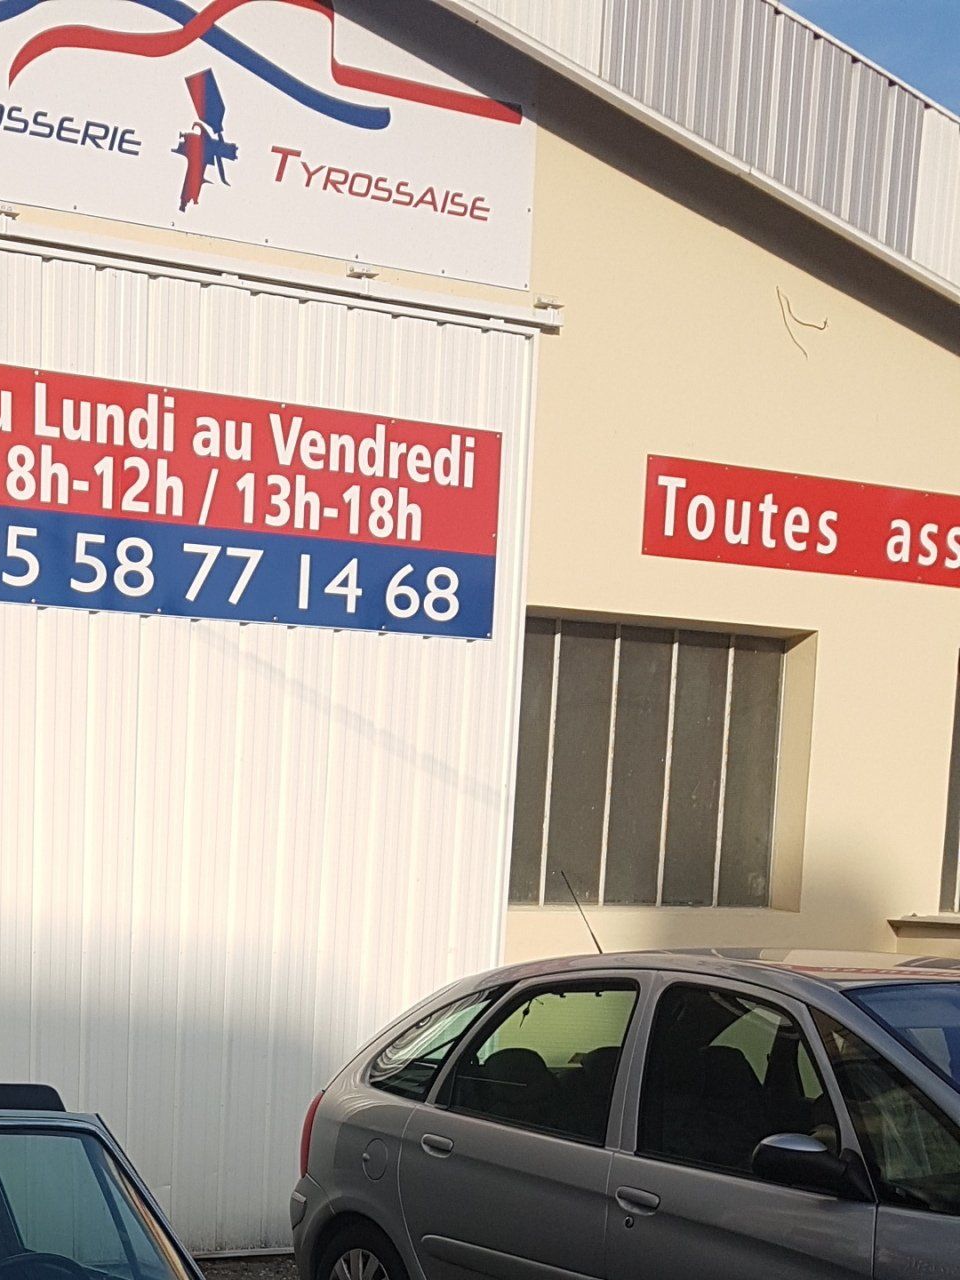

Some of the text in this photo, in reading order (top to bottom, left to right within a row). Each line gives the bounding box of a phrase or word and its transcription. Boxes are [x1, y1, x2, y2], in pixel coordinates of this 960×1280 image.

[270, 145, 491, 222] TYROSSAISE
[34, 381, 175, 452] Lundi
[192, 415, 252, 462] au
[269, 413, 475, 488] Vendredi
[5, 444, 183, 517] 8h-12h
[236, 472, 422, 542] 13h-18h
[657, 475, 839, 555] Toutes
[69, 532, 155, 597] 58
[182, 543, 264, 605] 77
[298, 553, 363, 613] 14
[385, 563, 460, 621] 68
